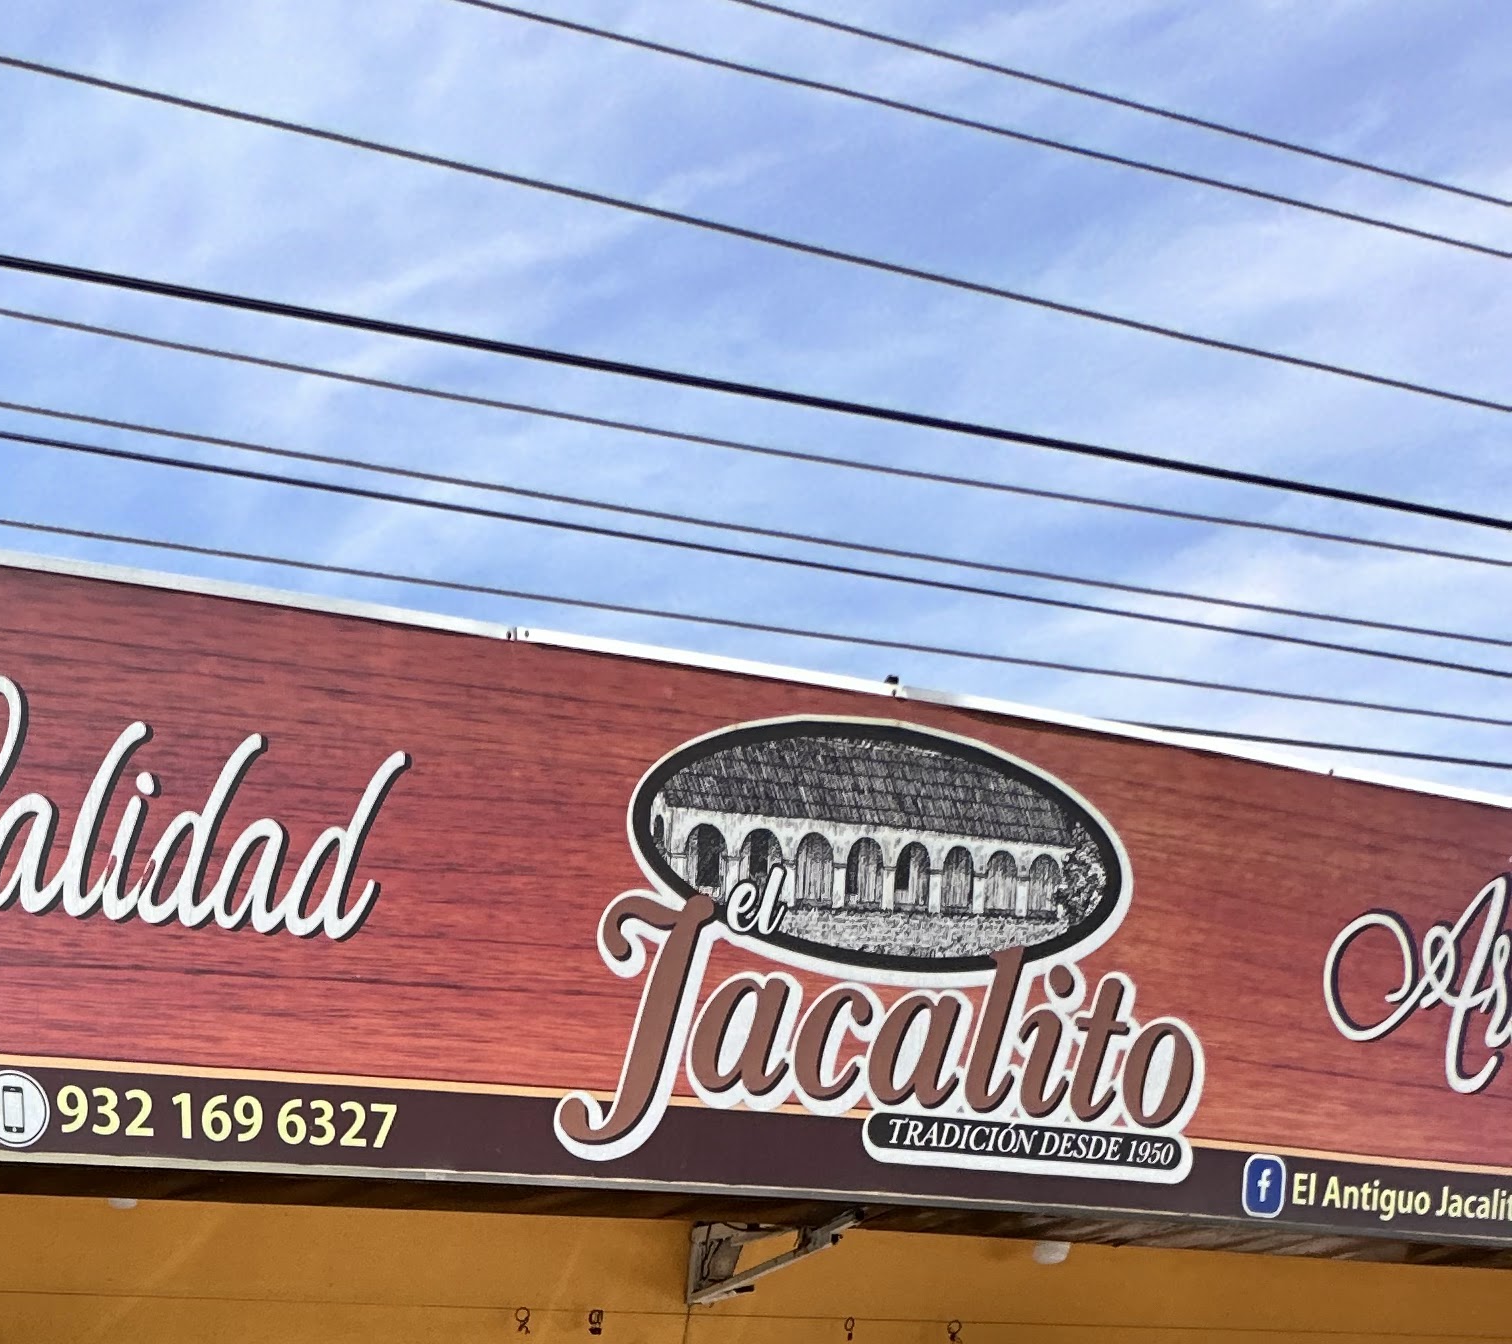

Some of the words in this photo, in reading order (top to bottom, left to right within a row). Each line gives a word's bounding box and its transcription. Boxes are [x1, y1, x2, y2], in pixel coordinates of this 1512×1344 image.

[726, 864, 786, 935] el
[557, 893, 1198, 1145] Jacalito
[57, 1084, 155, 1138] 932
[172, 1091, 263, 1143] 169
[276, 1097, 399, 1149] 6327
[888, 1116, 1039, 1156] TRADICIÓN
[1039, 1132, 1123, 1162] DESDE
[1126, 1139, 1175, 1167] 1950
[1292, 1172, 1318, 1206] El
[1321, 1175, 1433, 1221] Antiguo
